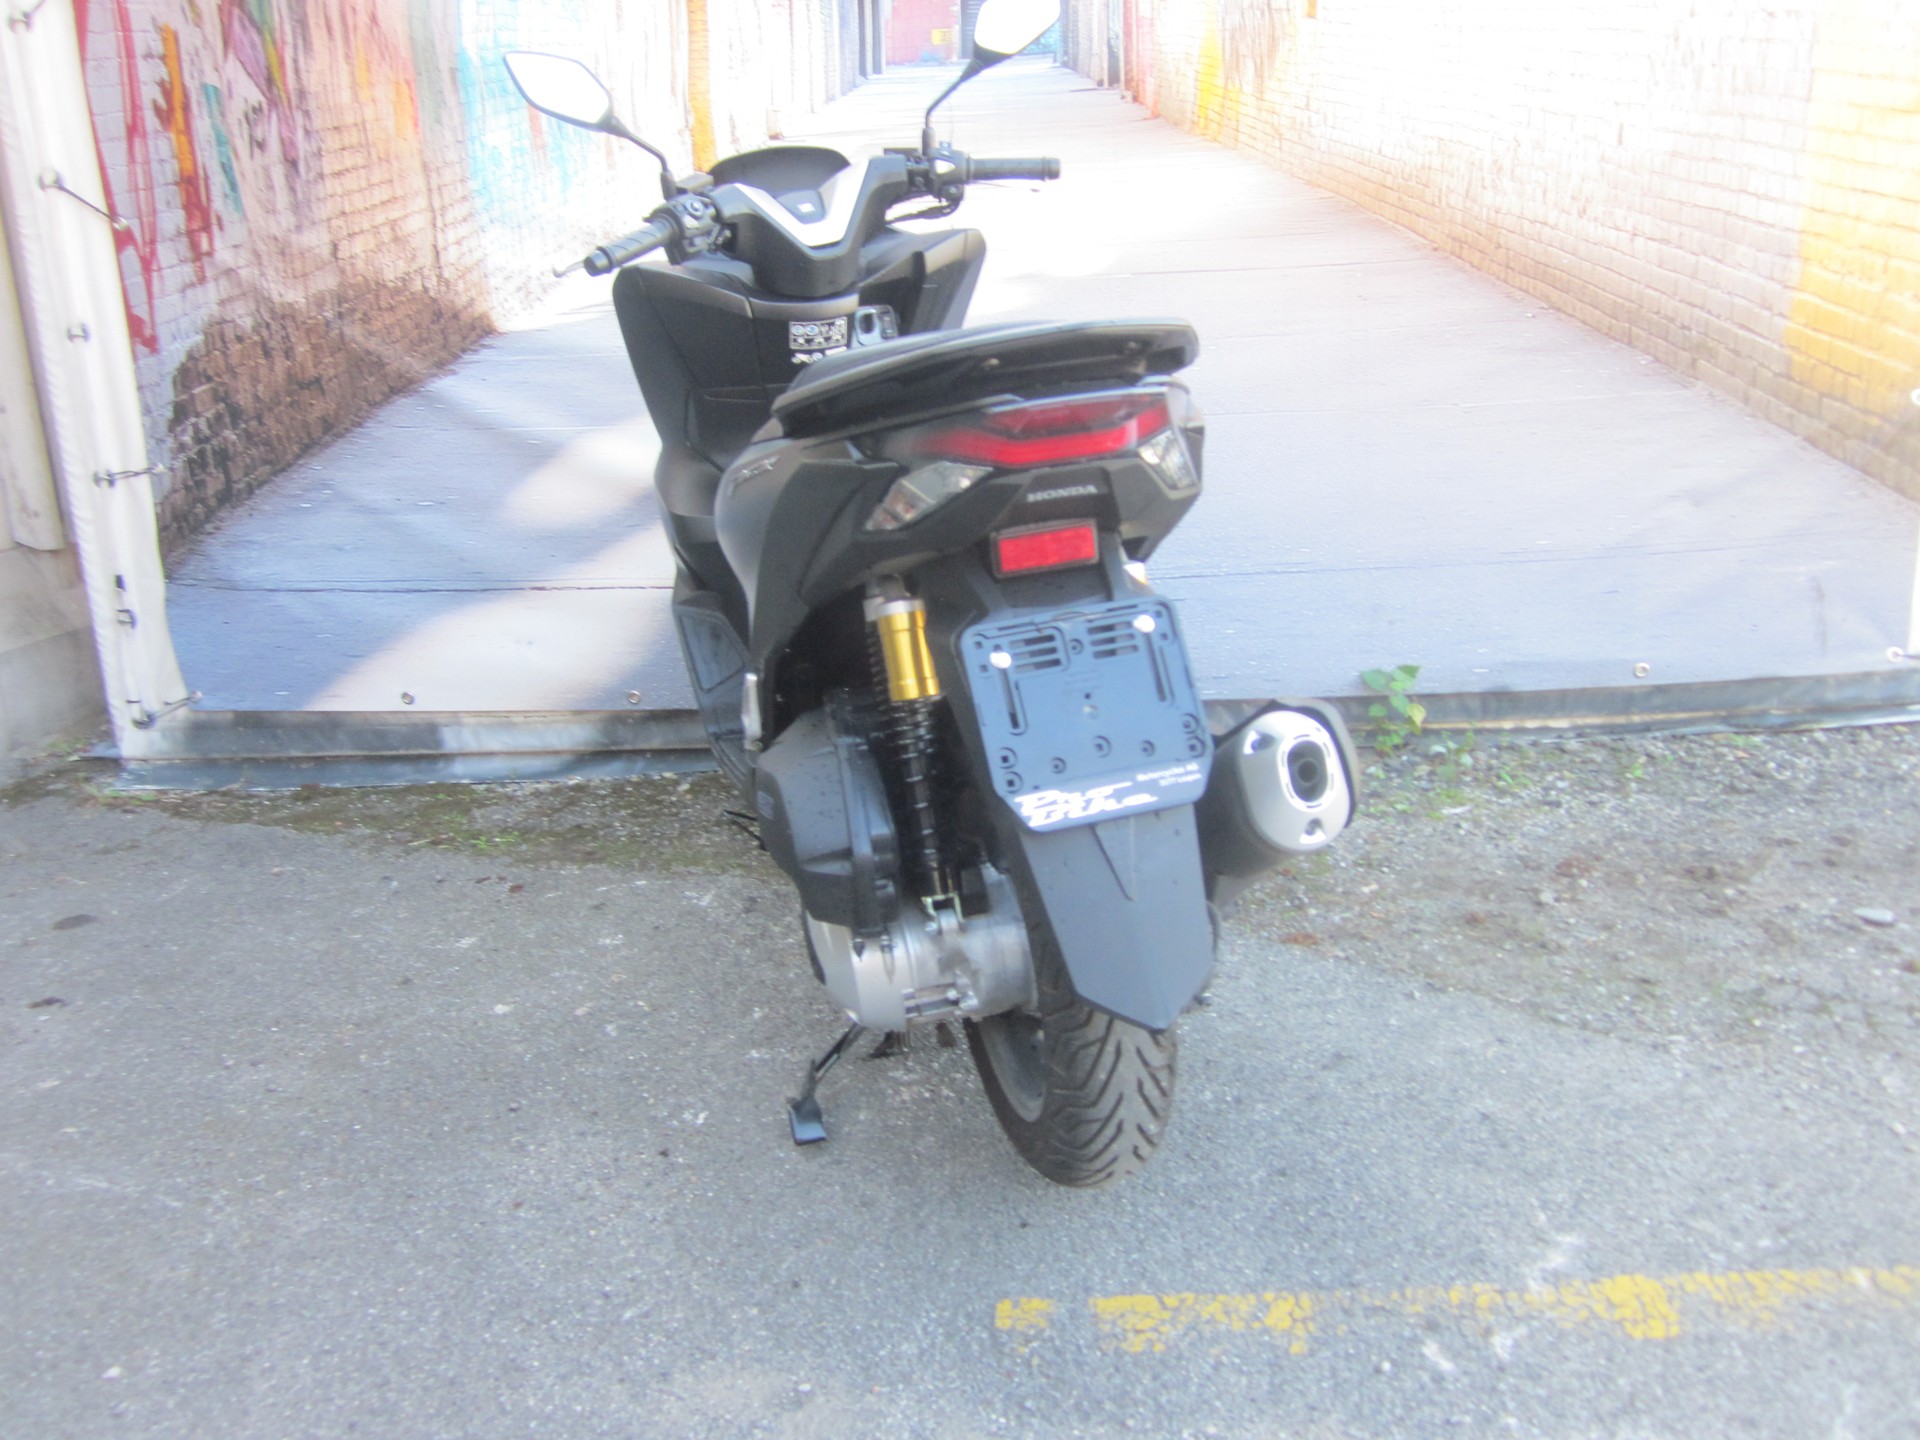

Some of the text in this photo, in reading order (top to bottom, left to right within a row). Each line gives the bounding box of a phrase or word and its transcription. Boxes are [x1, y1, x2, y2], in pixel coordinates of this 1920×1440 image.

[1026, 484, 1098, 502] HONDA
[1014, 781, 1133, 816] Pro
[1027, 793, 1159, 827] Bike
